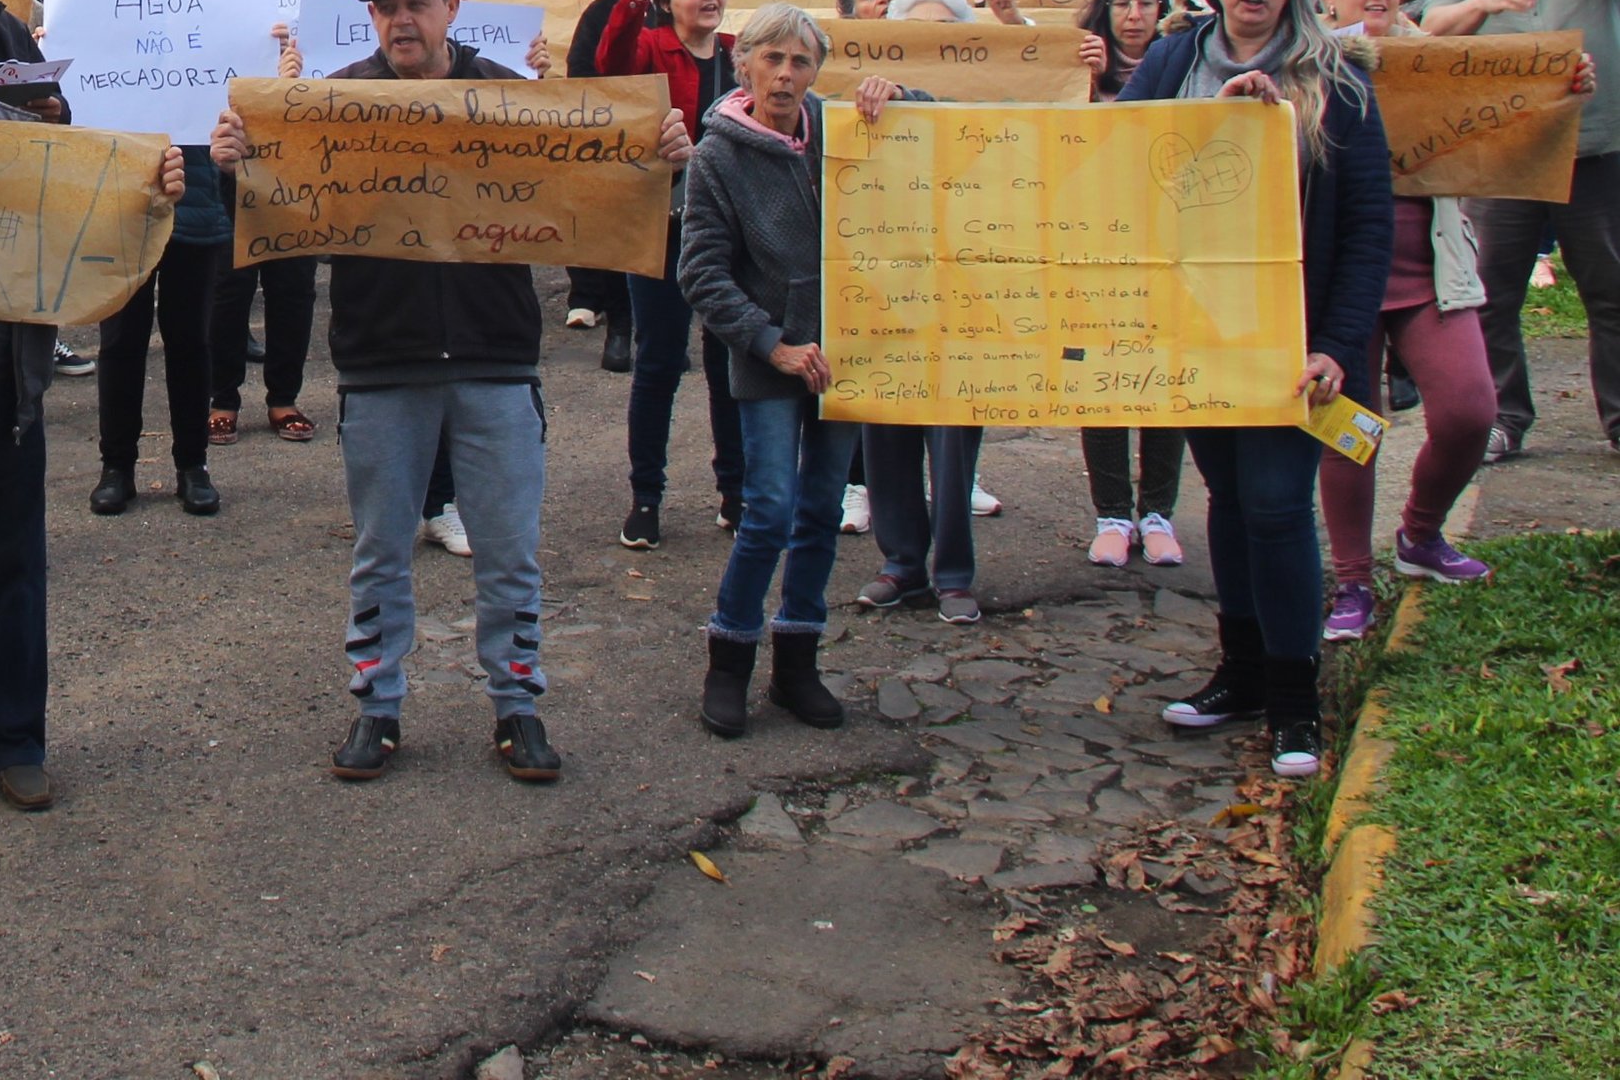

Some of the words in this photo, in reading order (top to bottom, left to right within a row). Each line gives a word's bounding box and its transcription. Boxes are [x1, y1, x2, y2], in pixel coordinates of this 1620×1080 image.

[137, 30, 173, 55] NÃO
[187, 25, 203, 49] É
[336, 14, 371, 46] LEI
[940, 36, 989, 64] não
[1021, 33, 1041, 62] é
[1412, 43, 1430, 74] é
[80, 67, 238, 92] MERCADORIA
[283, 83, 445, 125] Estamos
[465, 88, 613, 129] lutando
[855, 120, 920, 158] Aumento
[956, 125, 1019, 153] Injusto
[1060, 134, 1087, 143] na
[1390, 94, 1526, 170] rivilégio
[241, 139, 284, 177] por
[450, 129, 650, 171] igualdade
[241, 191, 257, 209] e
[268, 163, 451, 221] dignidade
[476, 178, 545, 203] no
[908, 175, 930, 191] da
[941, 176, 982, 196] água
[1011, 178, 1046, 191] Em
[247, 223, 376, 258] acesso
[837, 218, 938, 237] Condomínio
[1036, 221, 1089, 231] mais
[1108, 219, 1131, 232] de
[848, 251, 878, 272] 20
[956, 248, 1048, 266] Estamos
[840, 285, 871, 303] Por
[953, 286, 1041, 308] igualdade
[1049, 291, 1057, 299] e
[1065, 288, 1149, 302] dignidade
[840, 326, 859, 336] no
[871, 327, 916, 336] acesso
[958, 314, 1002, 338] água!
[1014, 317, 1048, 333] Sou
[1060, 318, 1146, 332] Aposentada
[1152, 322, 1159, 330] e
[884, 352, 940, 363] salário
[948, 352, 974, 361] não
[983, 352, 1042, 361] aumentou
[1103, 335, 1155, 357] 150%
[957, 380, 1018, 403] Ajudenos
[1093, 366, 1199, 394] 3157/2018
[1048, 403, 1070, 418] 40
[1076, 405, 1111, 415] anos
[1123, 403, 1158, 419] aqui
